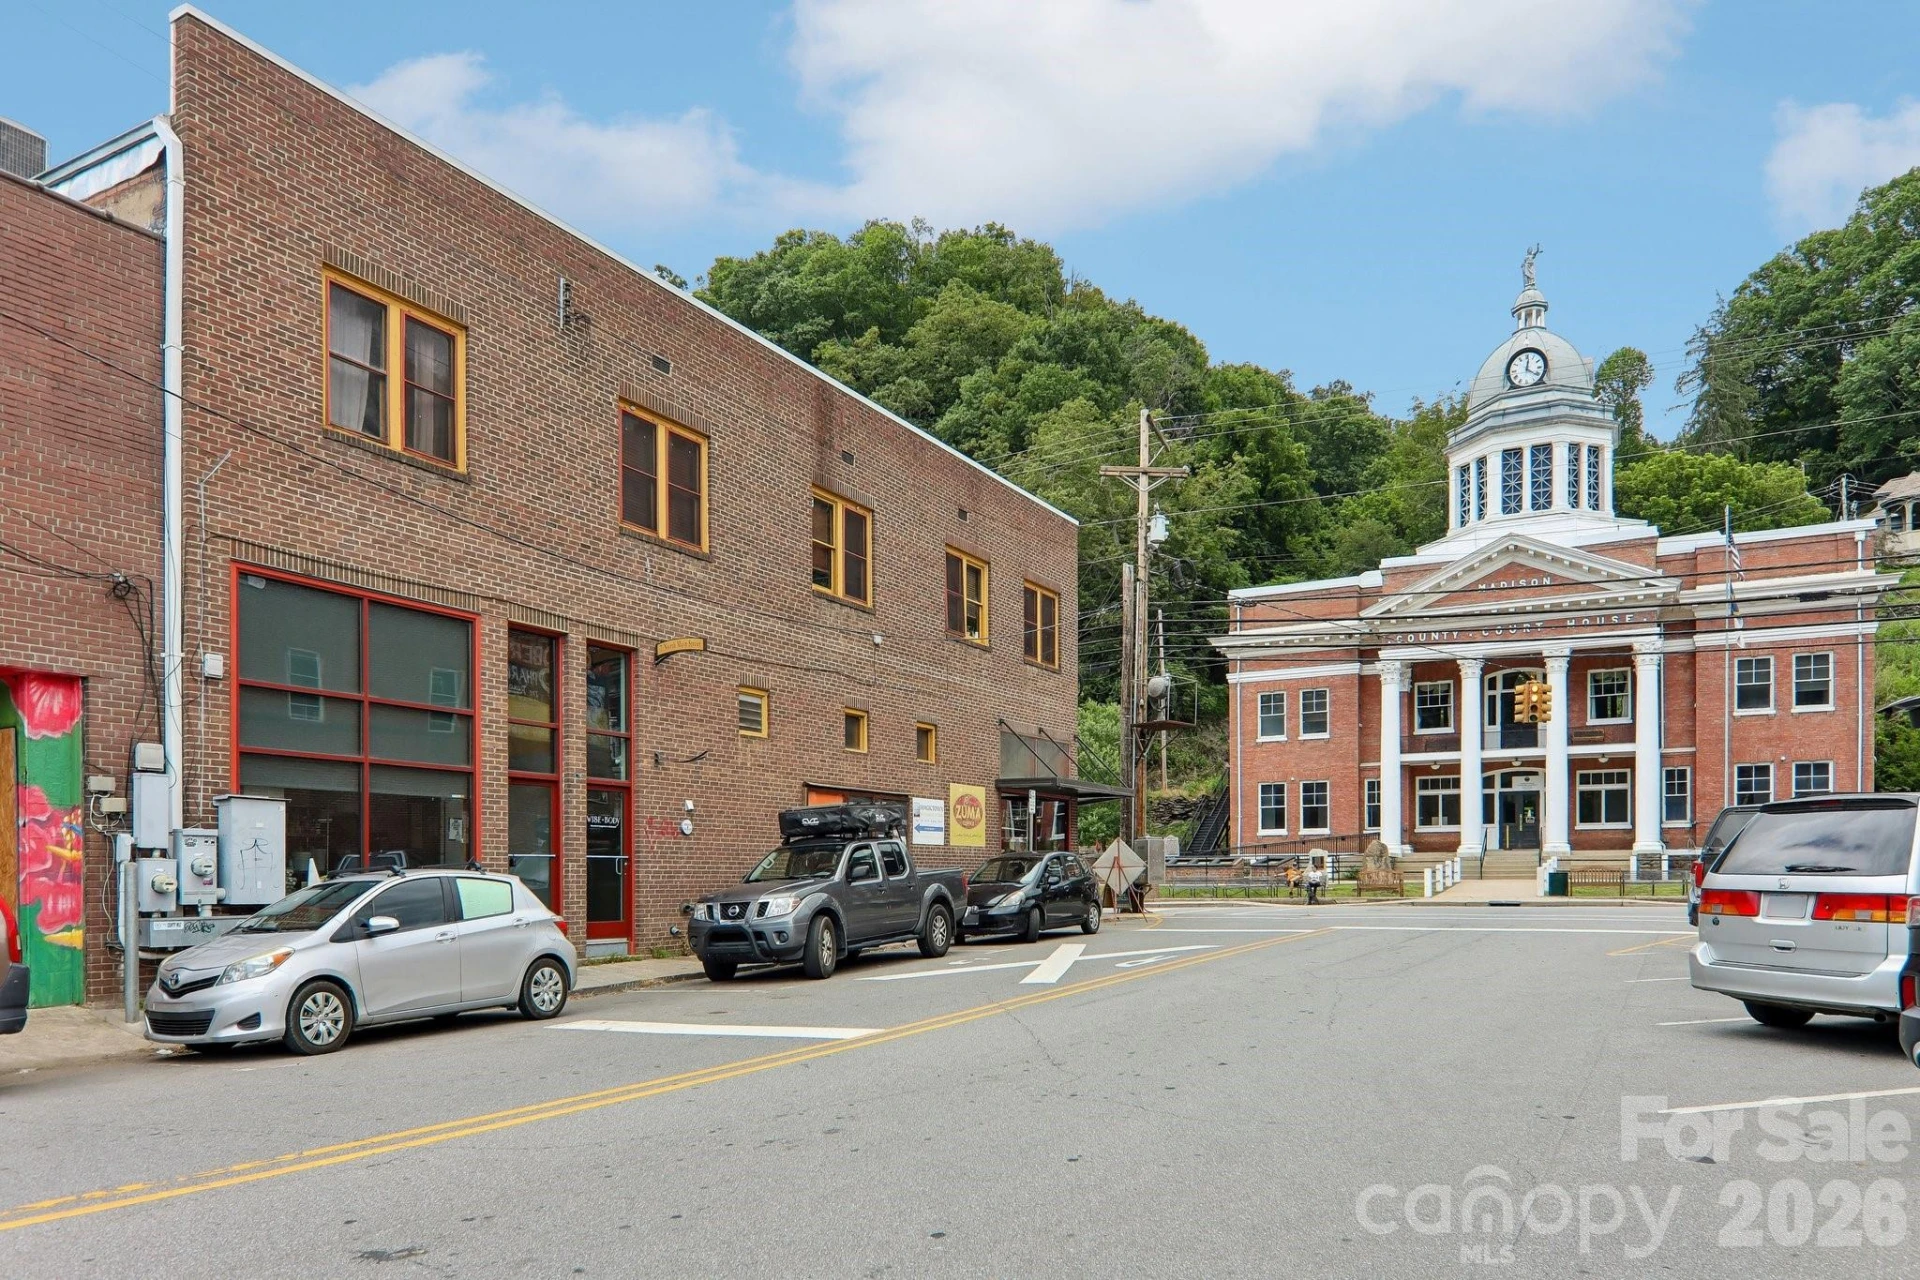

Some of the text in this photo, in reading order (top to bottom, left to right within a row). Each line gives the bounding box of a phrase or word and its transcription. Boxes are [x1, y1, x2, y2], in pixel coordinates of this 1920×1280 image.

[1478, 577, 1551, 594] MADISON
[1396, 614, 1634, 644] COUNTY COURT HOUSE
[955, 804, 981, 820] ZUMA
